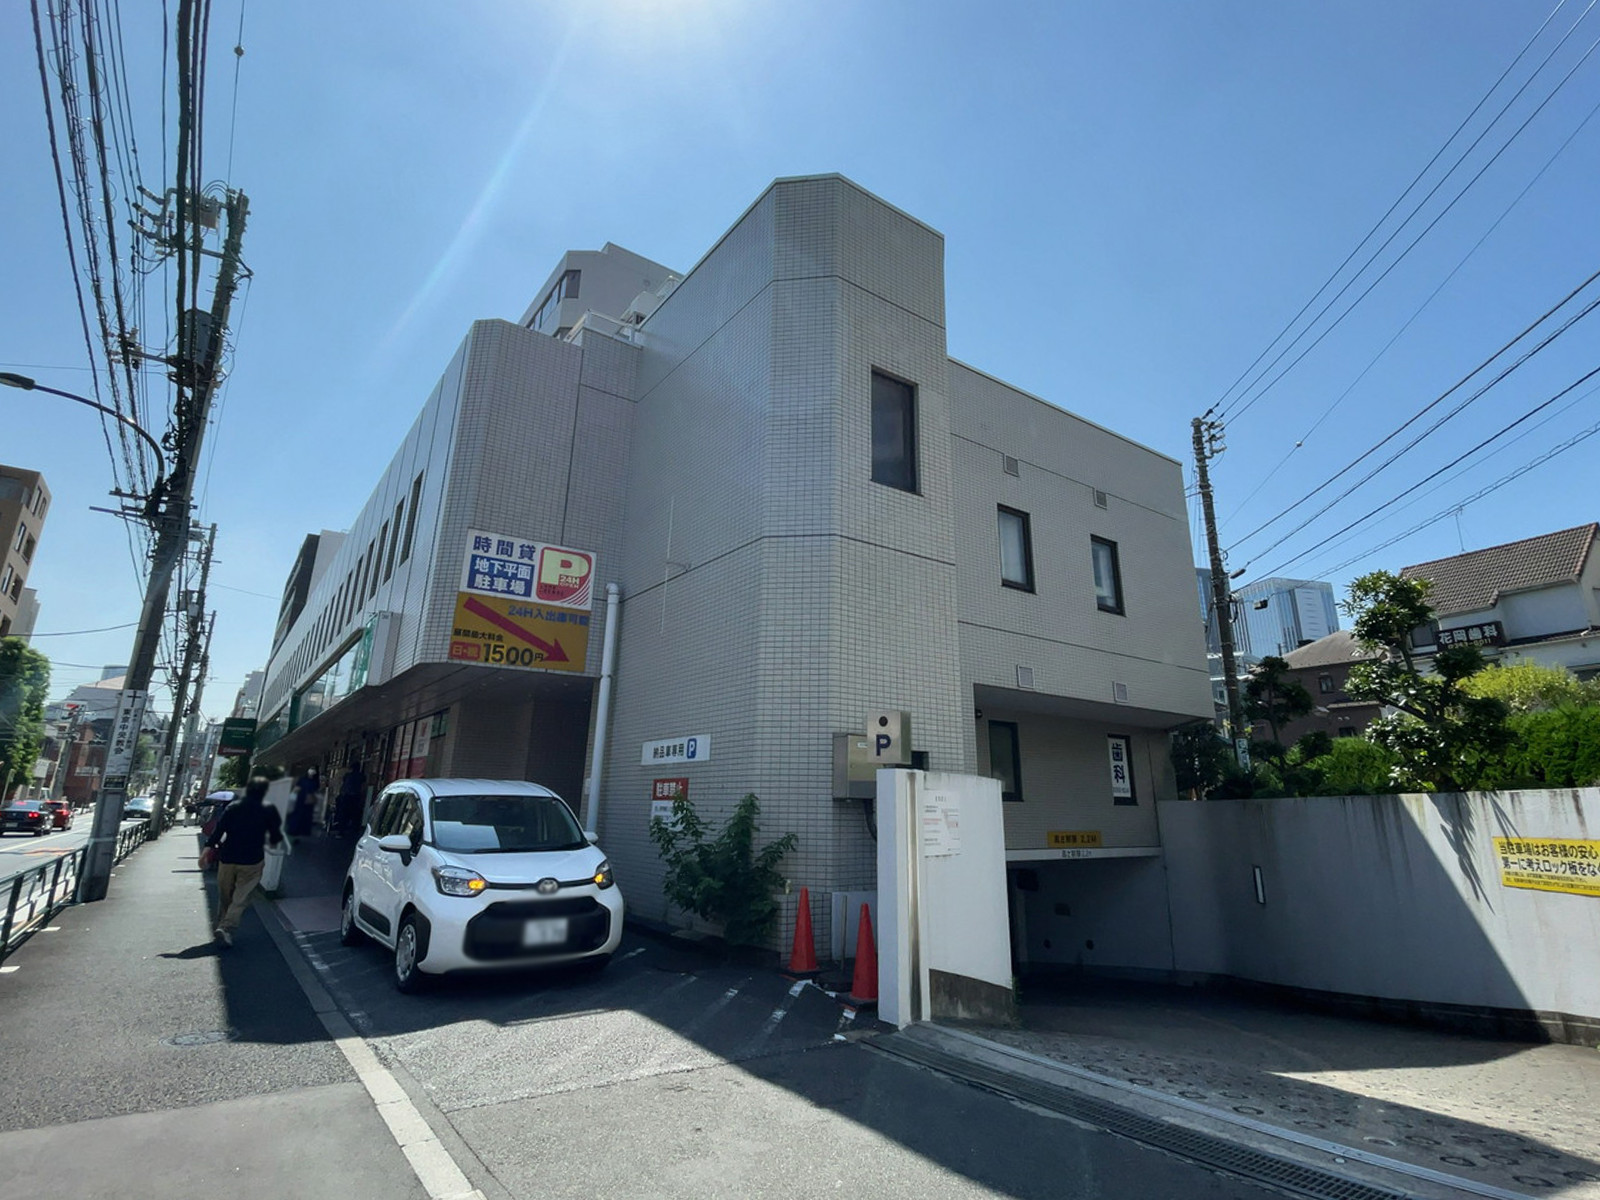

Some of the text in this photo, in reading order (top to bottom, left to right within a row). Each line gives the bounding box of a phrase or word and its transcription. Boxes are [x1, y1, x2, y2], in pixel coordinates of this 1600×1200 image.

[474, 535, 536, 561] 時間貸
[474, 557, 532, 580] 地下平面
[541, 549, 589, 585] P
[474, 573, 526, 595] 駐車場
[560, 575, 580, 586] 24H
[1440, 625, 1497, 644] 花岡歯科
[483, 643, 545, 666] 1500円
[688, 741, 696, 757] P
[876, 734, 892, 756] P
